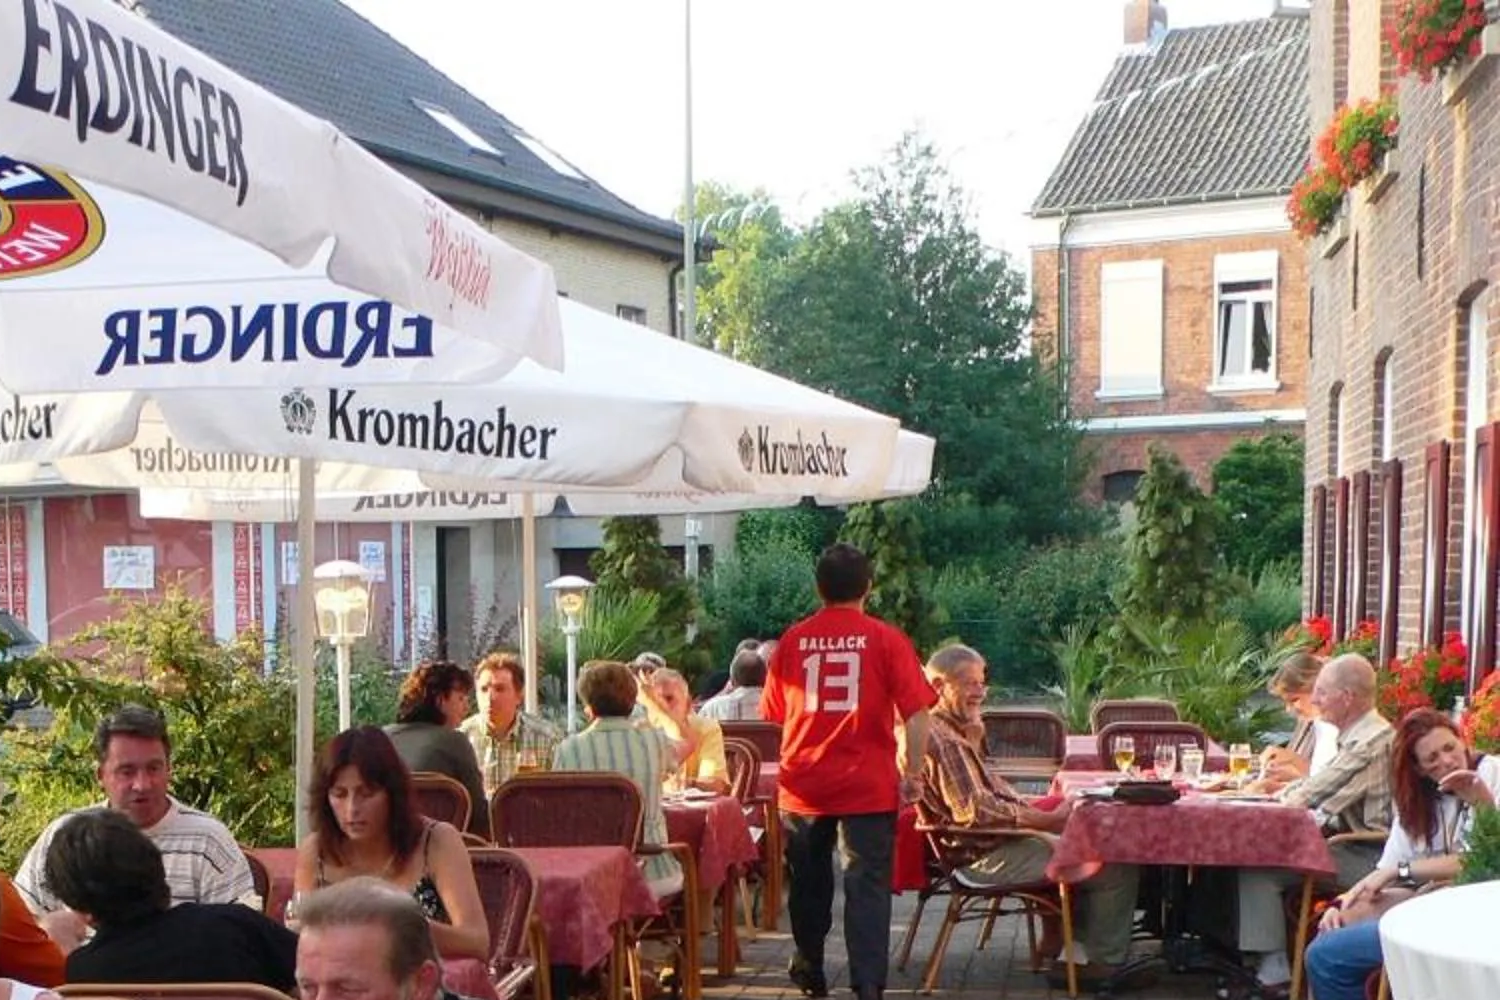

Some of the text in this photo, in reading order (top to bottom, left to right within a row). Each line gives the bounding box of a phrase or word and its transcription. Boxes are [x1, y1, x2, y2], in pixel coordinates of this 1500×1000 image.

[8, 0, 248, 207] ERDINGER
[327, 387, 557, 460] Krombacher
[757, 425, 848, 477] Krombacher
[799, 635, 867, 651] BALLACK
[803, 652, 861, 713] 13
